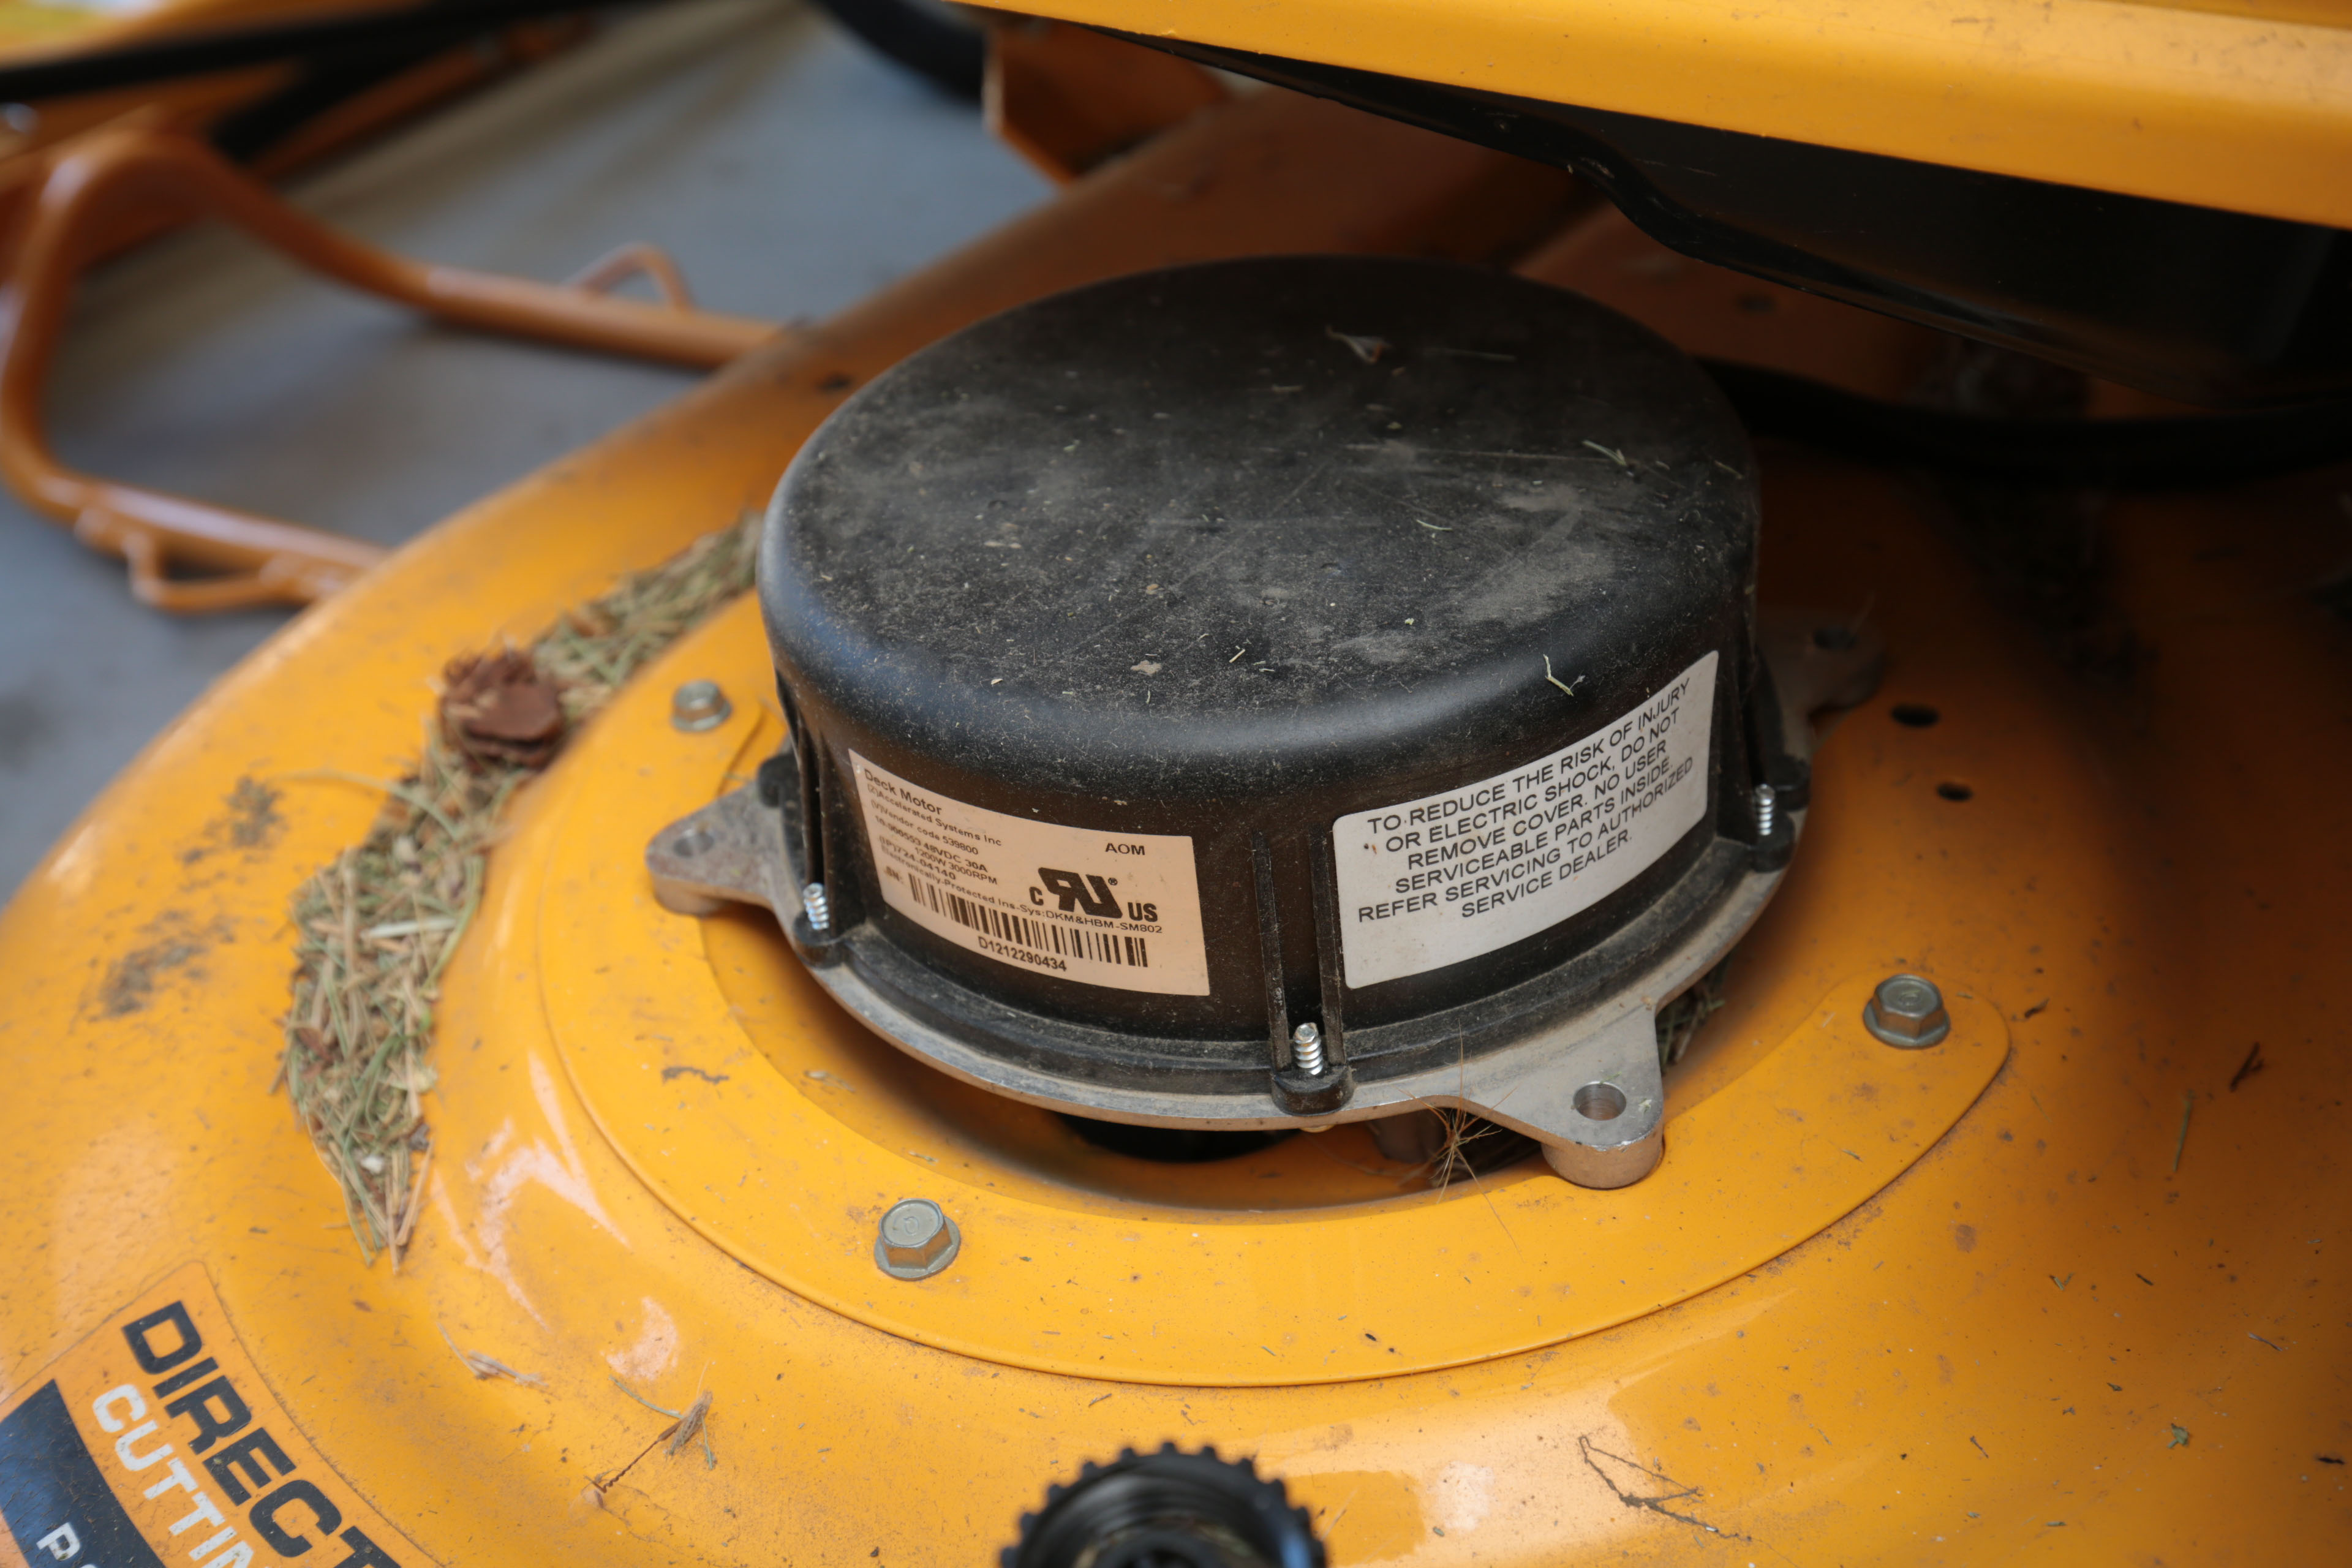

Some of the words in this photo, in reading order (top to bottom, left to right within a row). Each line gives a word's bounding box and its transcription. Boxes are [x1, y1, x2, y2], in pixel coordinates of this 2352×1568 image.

[1367, 815, 1401, 834] TO
[1410, 783, 1505, 826] REDUCE
[1512, 764, 1553, 793] THE
[1561, 738, 1604, 774] RISK
[1610, 722, 1633, 746] OF
[1638, 677, 1690, 730] INJURY
[864, 769, 897, 796] Deck
[900, 788, 942, 815] Motor
[1386, 832, 1421, 851] OR
[1430, 794, 1537, 843] ELECTRIC
[1545, 756, 1615, 802] SHOCK,
[1622, 736, 1645, 762] DO
[1650, 707, 1679, 742] NOT
[1395, 831, 1548, 893] SERVICEABLE
[1556, 797, 1615, 840] PARTS
[1621, 758, 1673, 804] INSIDE.
[1409, 827, 1506, 870] REMOVE
[1513, 794, 1588, 836] COVER.
[1595, 774, 1619, 799] NO
[1626, 739, 1666, 780] USER
[917, 827, 940, 840] code
[942, 835, 979, 855] 539800
[935, 817, 981, 840] Systems
[984, 835, 1002, 846] Inc
[1105, 842, 1145, 856] AOM
[1359, 892, 1438, 922] REFER
[1446, 848, 1561, 902] SERVICING
[1567, 832, 1592, 853] TO
[1598, 756, 1692, 839] AUTHORIZED
[914, 847, 946, 867] 1200W
[948, 862, 997, 885] 3000RPM
[924, 842, 961, 863] 48VDC
[965, 859, 988, 872] 30A
[1462, 871, 1552, 918] SERVICE
[1560, 829, 1632, 880] DEALER.
[978, 936, 1066, 971] D1212290434
